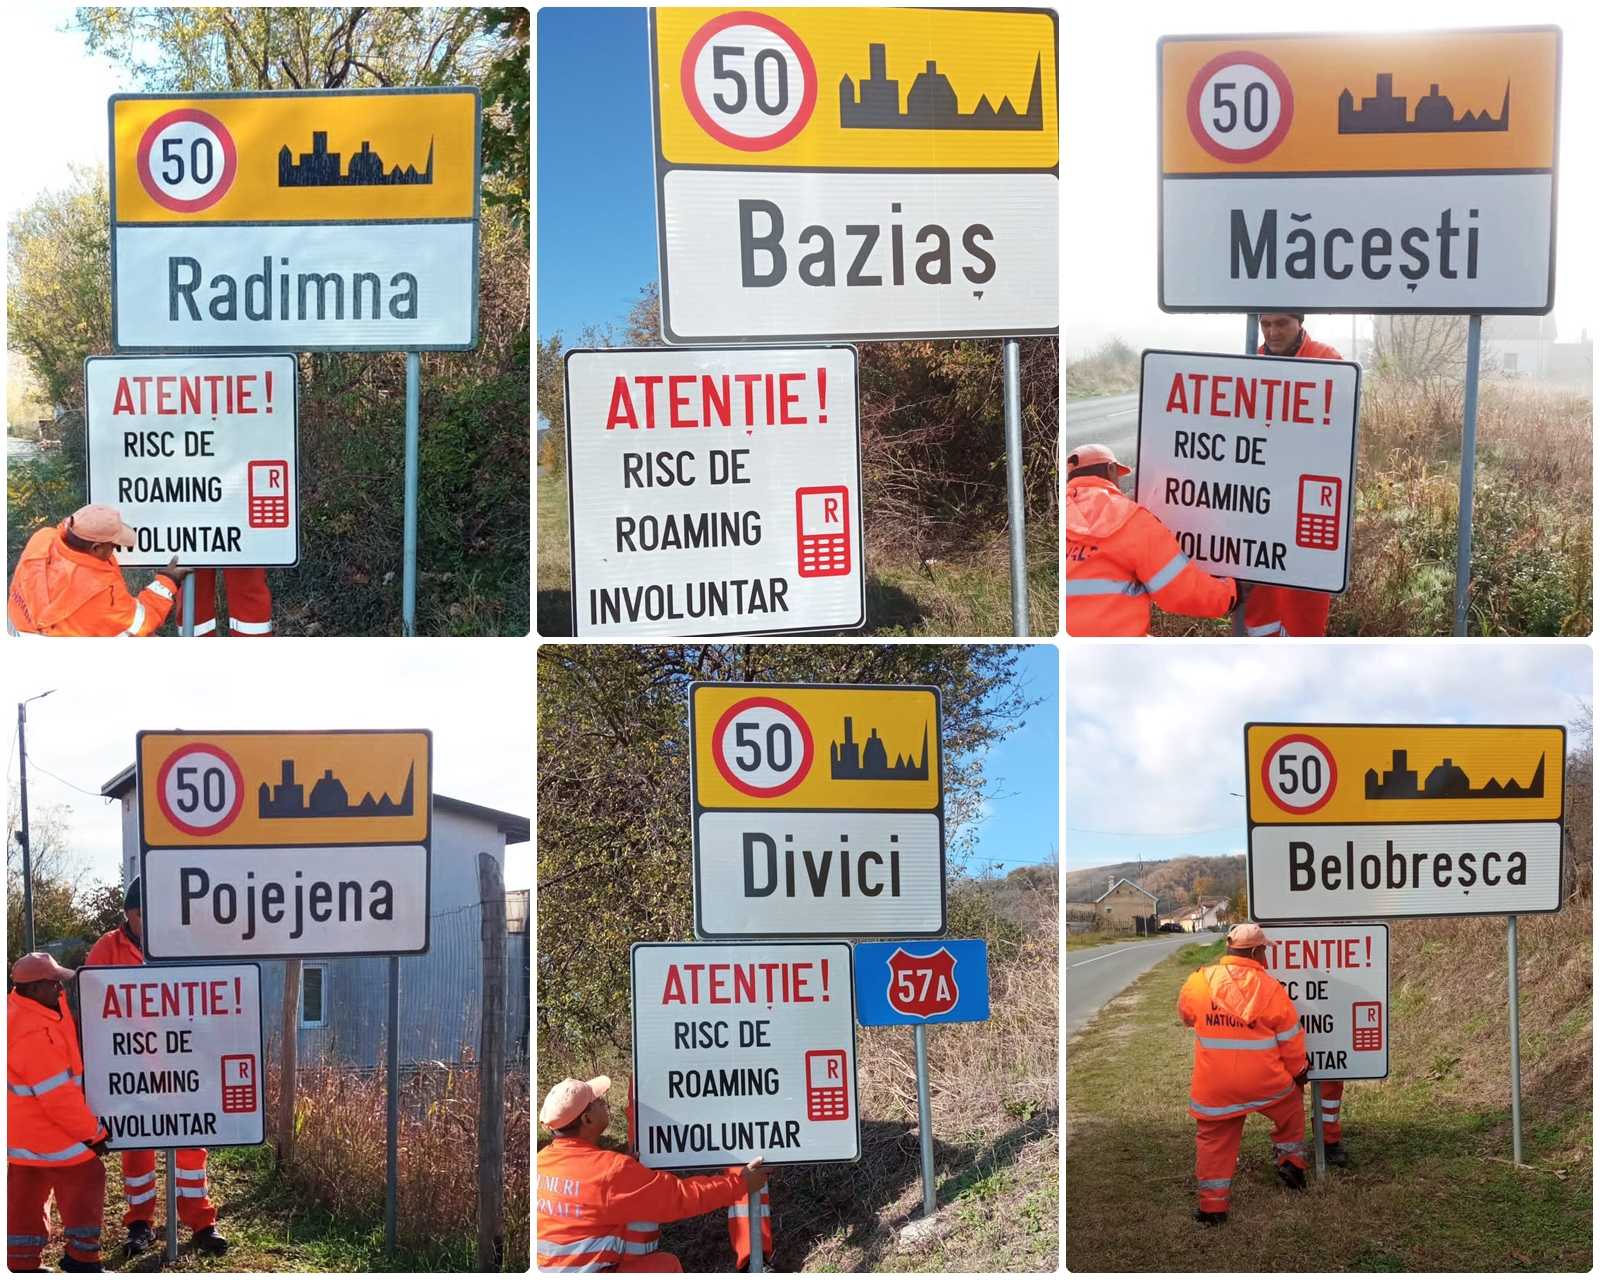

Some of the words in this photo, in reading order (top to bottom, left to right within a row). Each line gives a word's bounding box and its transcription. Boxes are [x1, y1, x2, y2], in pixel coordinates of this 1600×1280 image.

[712, 46, 789, 115] 50
[1213, 82, 1268, 133] 50
[163, 138, 213, 185] 50
[739, 199, 996, 300] Baziaș
[1231, 208, 1478, 293] Măcești
[169, 256, 417, 321] Radimna
[113, 371, 272, 420] ATENȚIE!
[607, 368, 827, 435] ATENȚIE!
[1166, 373, 1332, 427] ATENȚIE!
[124, 431, 174, 457] RISC
[185, 431, 214, 456] DE
[1175, 431, 1226, 461] RISC
[1235, 436, 1267, 465] DE
[270, 469, 279, 488] R
[624, 451, 695, 488] RISC
[710, 449, 750, 484] DE
[119, 477, 221, 502] ROAMING
[1166, 478, 1270, 514] ROAMING
[1320, 486, 1333, 508] R
[825, 498, 838, 523] R
[115, 527, 242, 553] OLUNTAR
[616, 511, 761, 552] ROAMING
[591, 578, 788, 625] INVOLUNTAR
[735, 723, 793, 773] 50
[177, 767, 226, 812] 50
[1278, 754, 1322, 795] 50
[743, 833, 900, 897] Divici
[1289, 840, 1526, 895] Belobreșca
[181, 868, 393, 940] Pojejena
[103, 977, 241, 1021] ATENȚIE!
[663, 959, 829, 1009] ATENȚIE!
[898, 970, 951, 1003] 57A
[1306, 981, 1328, 1000] DE
[1367, 1007, 1376, 1022] R
[113, 1032, 157, 1055] RISC
[166, 1030, 192, 1053] DE
[675, 1021, 728, 1049] RISC
[740, 1020, 771, 1047] DE
[109, 1070, 199, 1095] ROAMING
[239, 1062, 249, 1079] R
[669, 1068, 779, 1098] ROAMING
[828, 1059, 838, 1078] R
[97, 1112, 217, 1137] NVOLUNTAR
[649, 1121, 800, 1154] INVOLUNTAR
